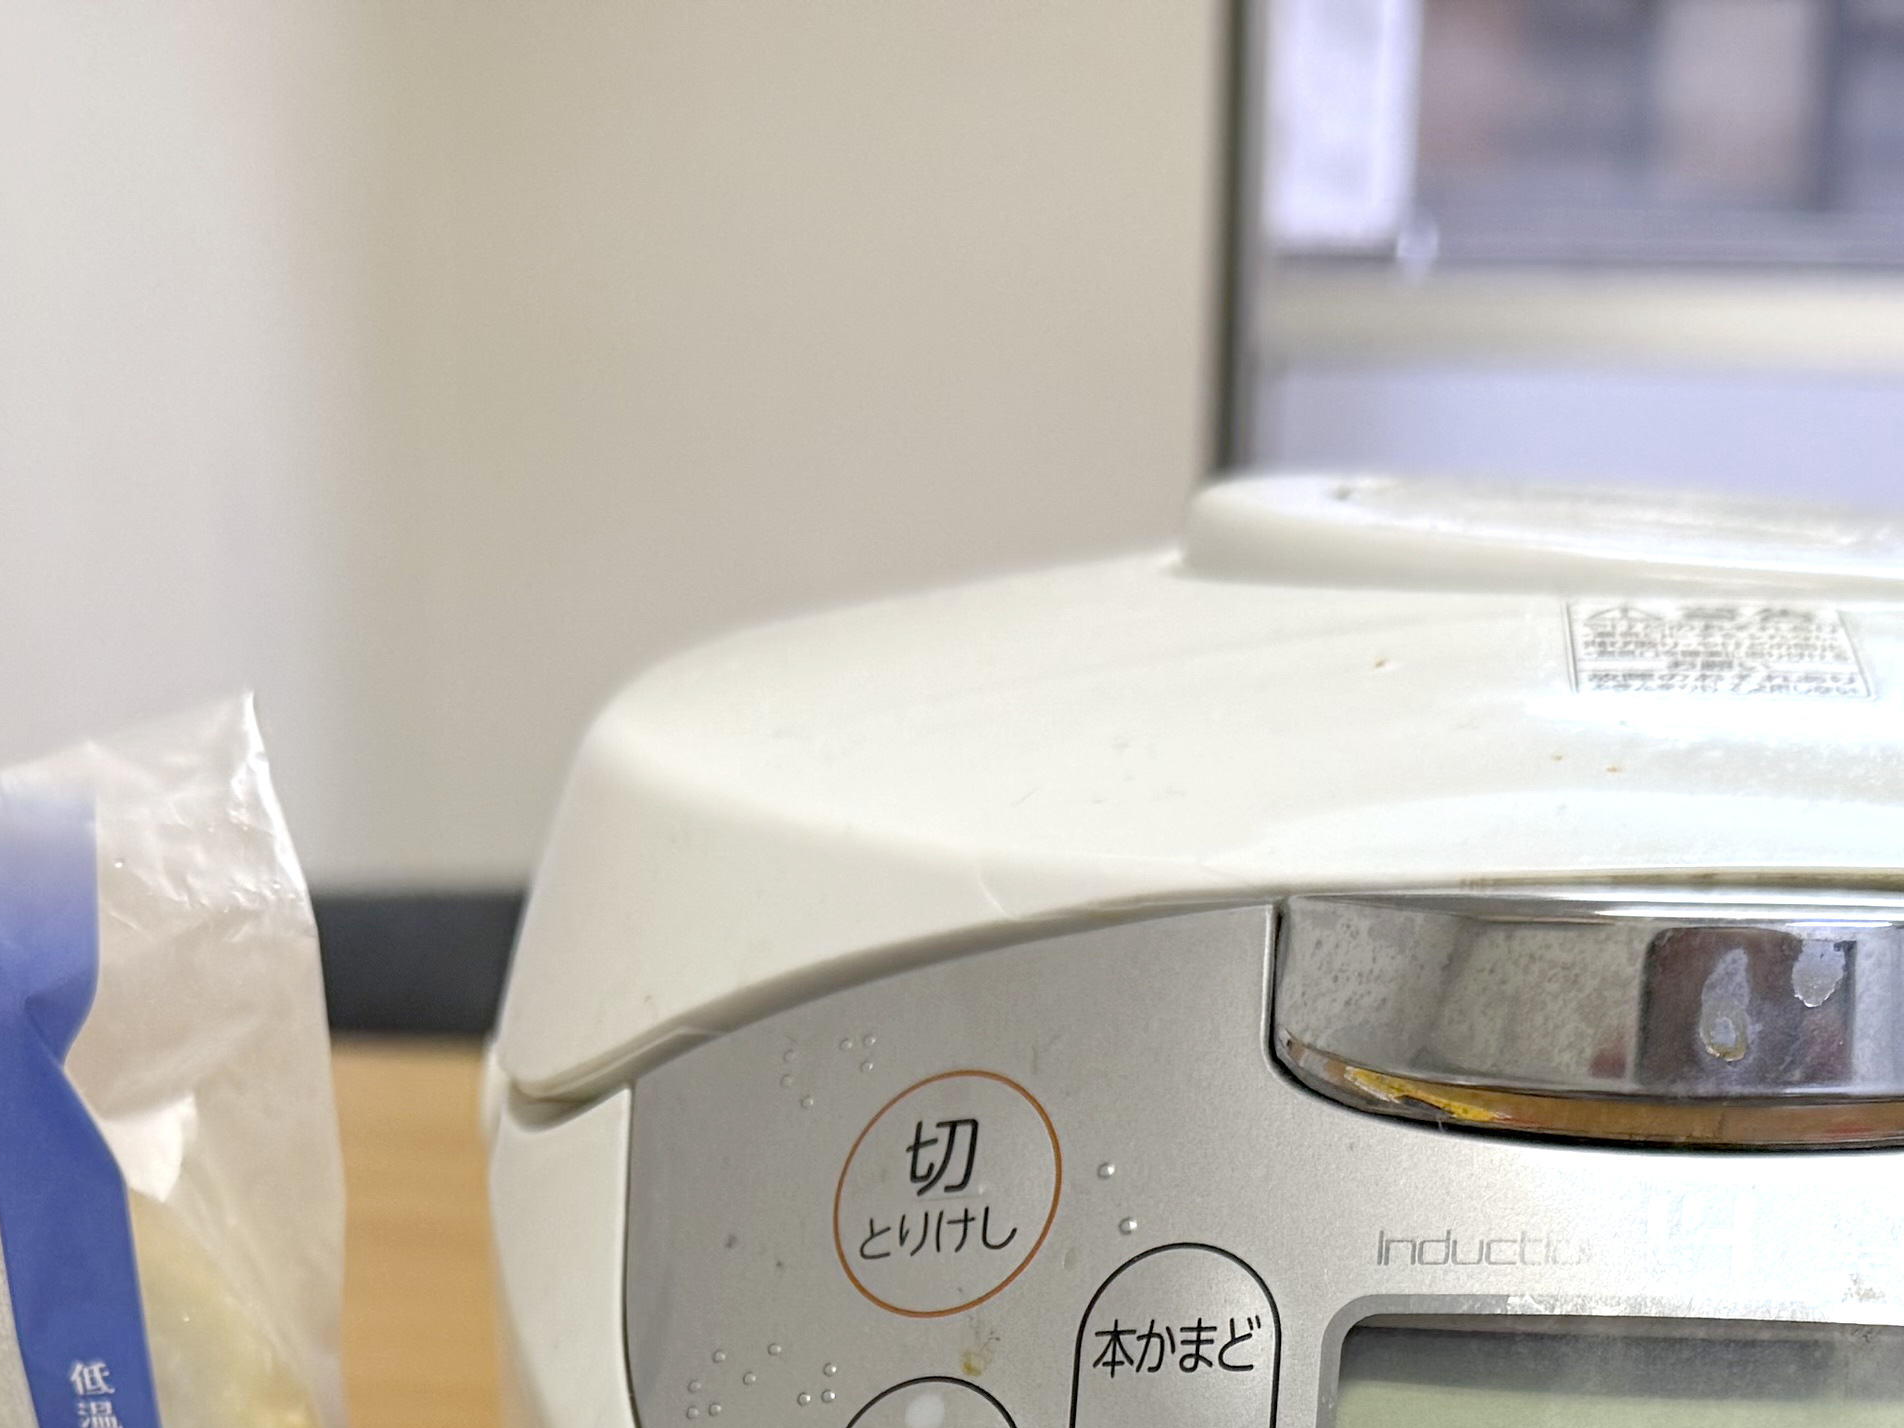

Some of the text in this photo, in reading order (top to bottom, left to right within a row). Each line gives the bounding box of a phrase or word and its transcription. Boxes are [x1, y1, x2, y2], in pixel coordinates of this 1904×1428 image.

[907, 1118, 979, 1197] 切
[859, 1206, 1017, 1262] とりけし
[1093, 1315, 1262, 1378] 本かまど
